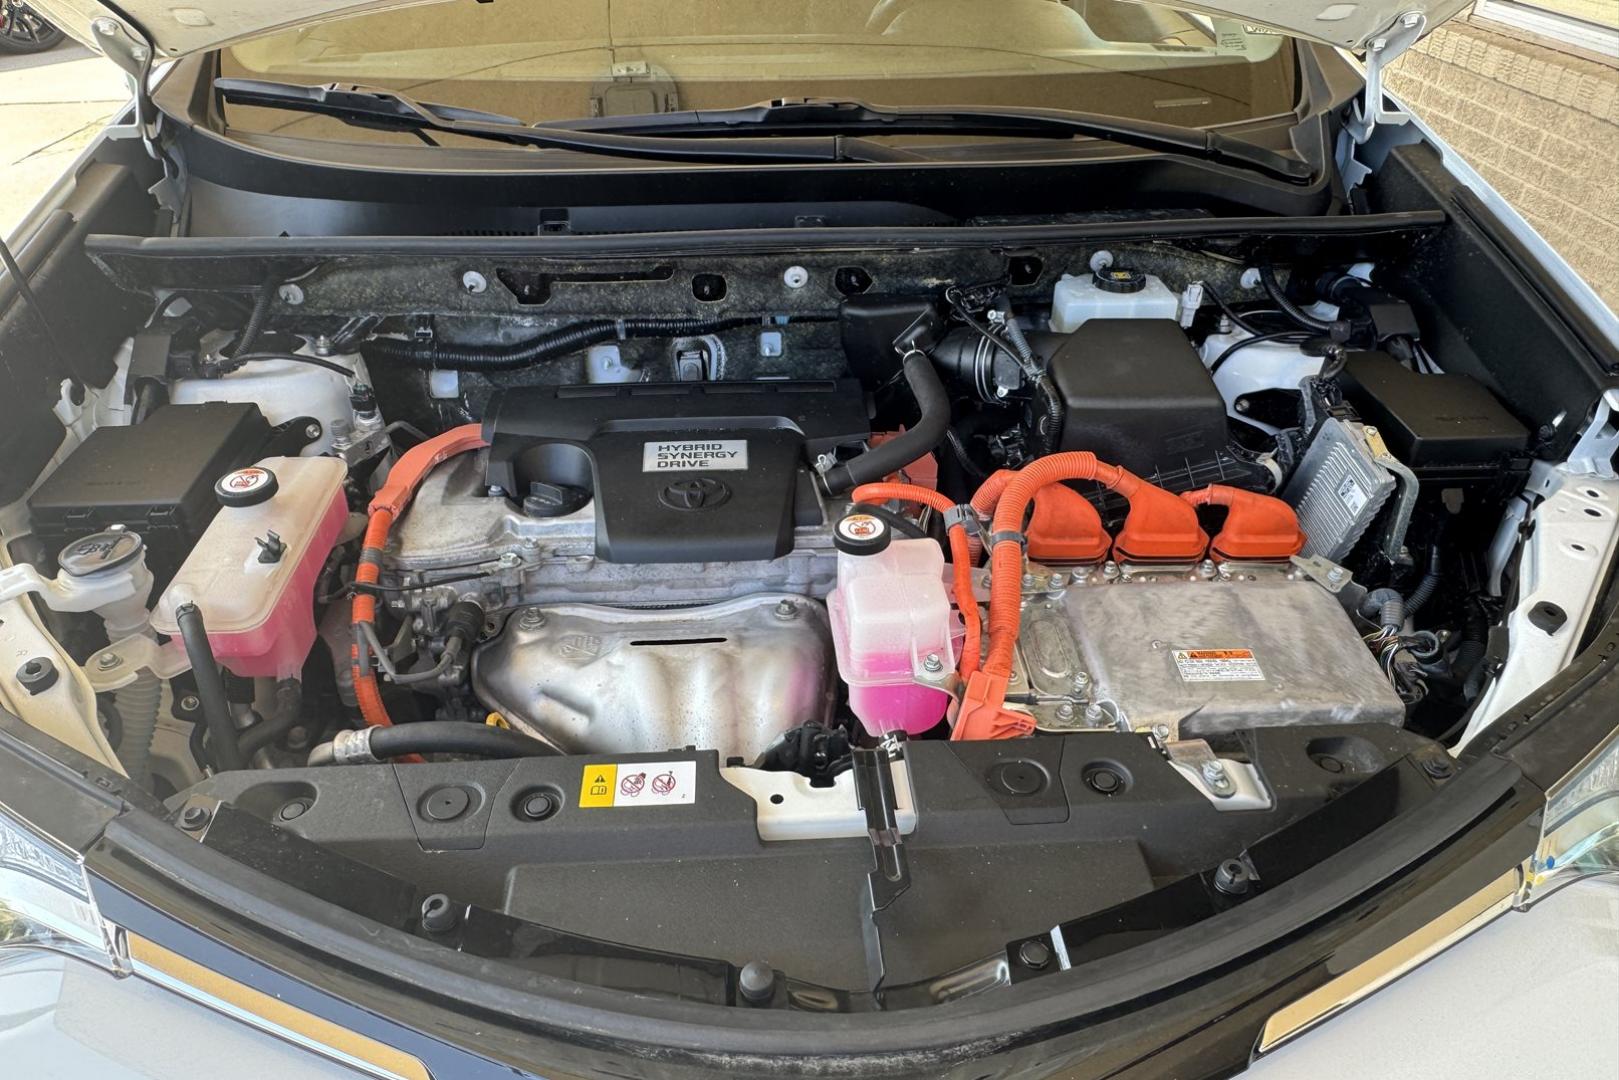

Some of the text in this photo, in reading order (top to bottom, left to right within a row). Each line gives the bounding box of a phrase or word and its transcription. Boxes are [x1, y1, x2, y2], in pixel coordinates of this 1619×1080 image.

[658, 443, 723, 452] HYBRID
[657, 451, 739, 460] SYNERGY
[657, 459, 710, 468] DRIVE
